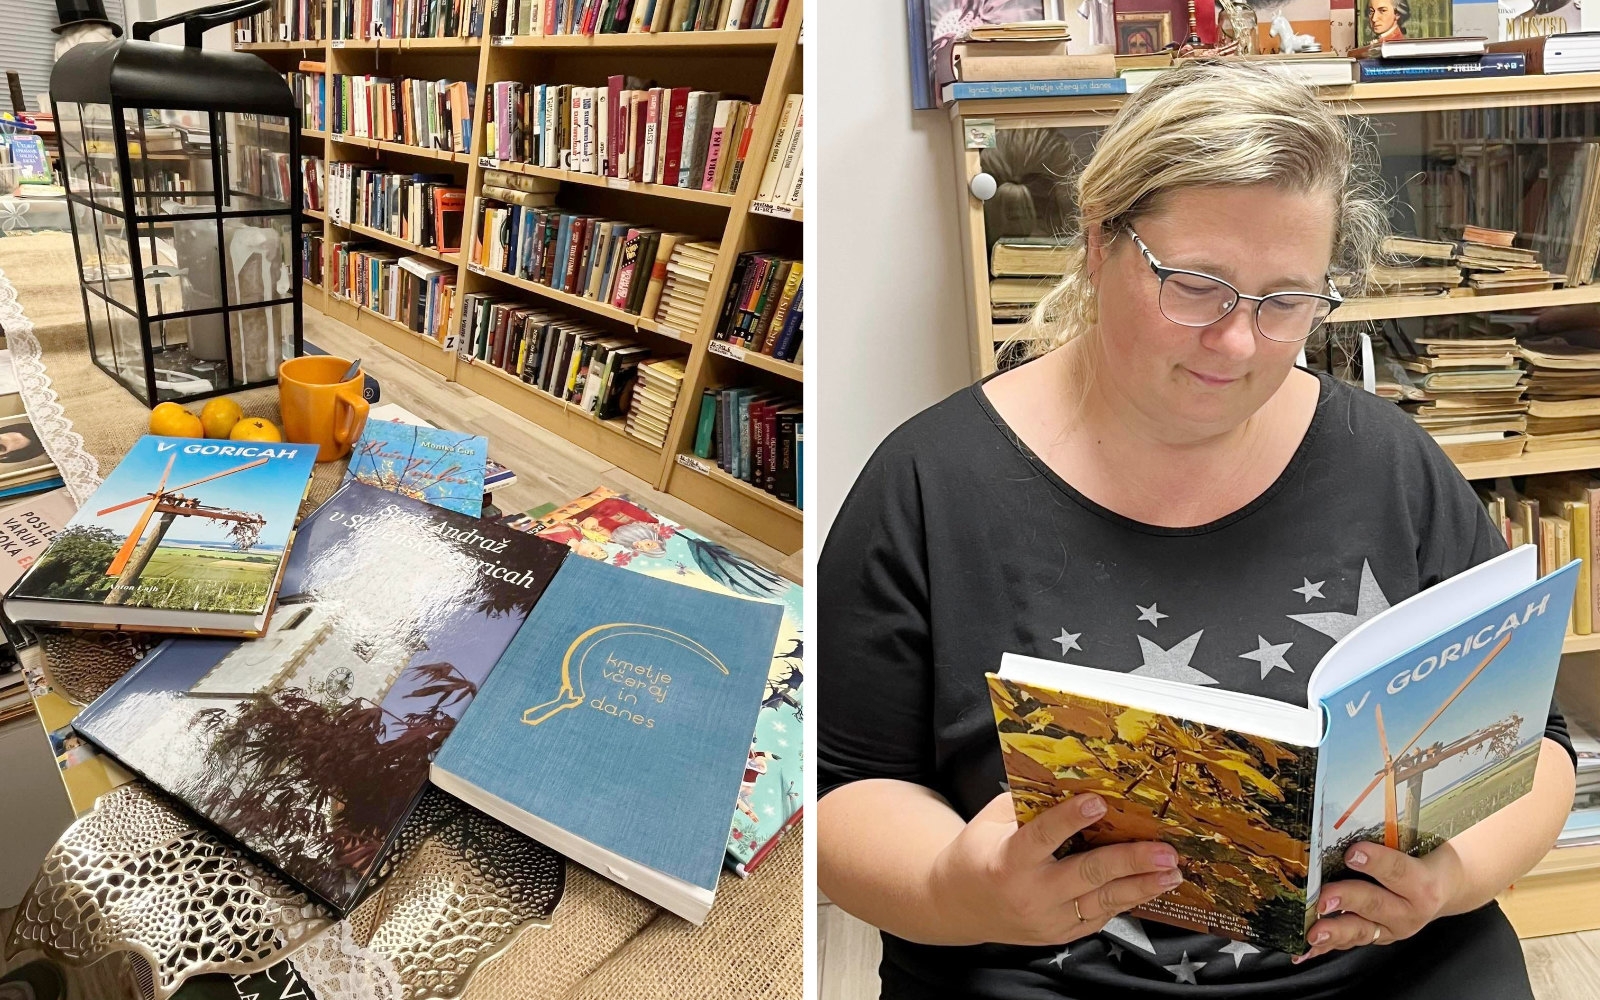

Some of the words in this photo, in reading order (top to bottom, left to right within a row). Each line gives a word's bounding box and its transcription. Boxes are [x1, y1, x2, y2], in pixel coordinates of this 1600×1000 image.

[374, 23, 383, 37] K
[1090, 82, 1112, 90] danes
[434, 135, 442, 149] N
[647, 124, 655, 145] SESTRE
[707, 158, 718, 182] SOBA
[446, 337, 455, 349] Z
[157, 441, 177, 452] V
[183, 444, 298, 459] GORICAH
[421, 441, 455, 453] Monika
[3, 517, 42, 548] VARUH
[379, 504, 433, 533] Sveti
[433, 520, 511, 554] Andraž
[328, 511, 345, 522] v
[446, 552, 535, 589] goricah
[1344, 690, 1371, 718] V
[1386, 593, 1551, 696] GORICAH
[606, 651, 672, 685] kmetje
[603, 668, 670, 703] včeraj
[618, 687, 638, 705] in
[590, 696, 656, 728] danes
[1169, 905, 1217, 922] Slovenskih
[1219, 919, 1253, 931] goricah
[1191, 917, 1219, 928] krajih
[1208, 911, 1240, 922] običaji
